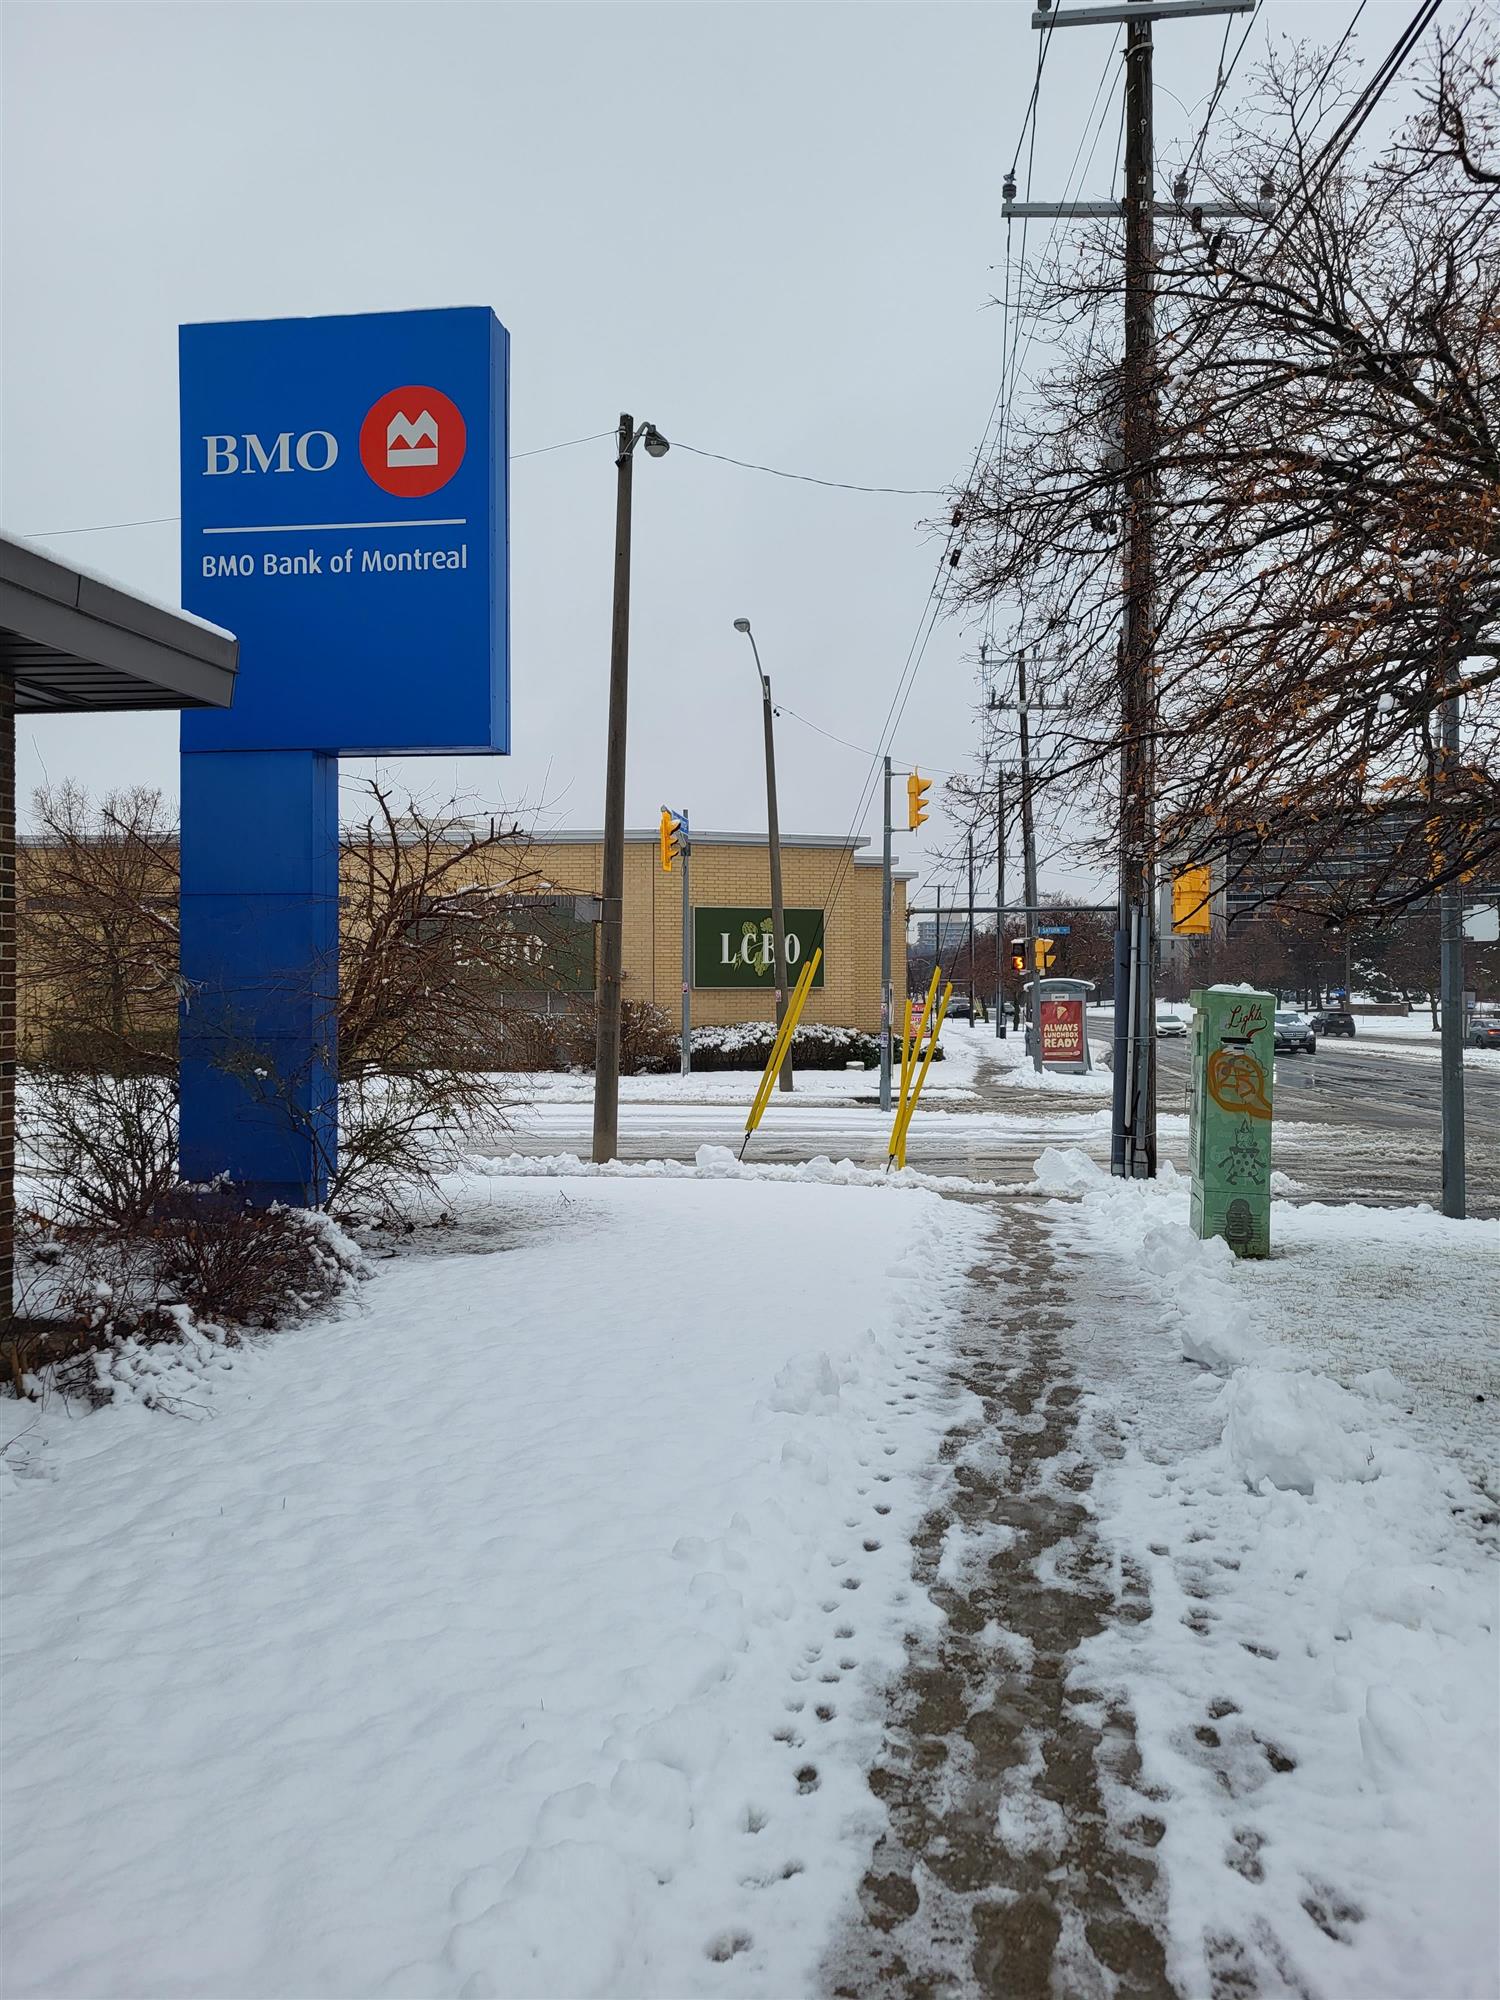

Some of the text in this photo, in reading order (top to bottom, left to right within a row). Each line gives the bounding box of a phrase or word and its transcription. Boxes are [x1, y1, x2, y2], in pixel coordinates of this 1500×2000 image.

[202, 430, 339, 476] BMO
[202, 544, 467, 577] BMO Bank of Montreal
[720, 933, 801, 964] LCBO
[1044, 1023, 1078, 1032] ALWAYS
[1225, 1003, 1263, 1034] Lights
[1044, 1038, 1079, 1048] READY
